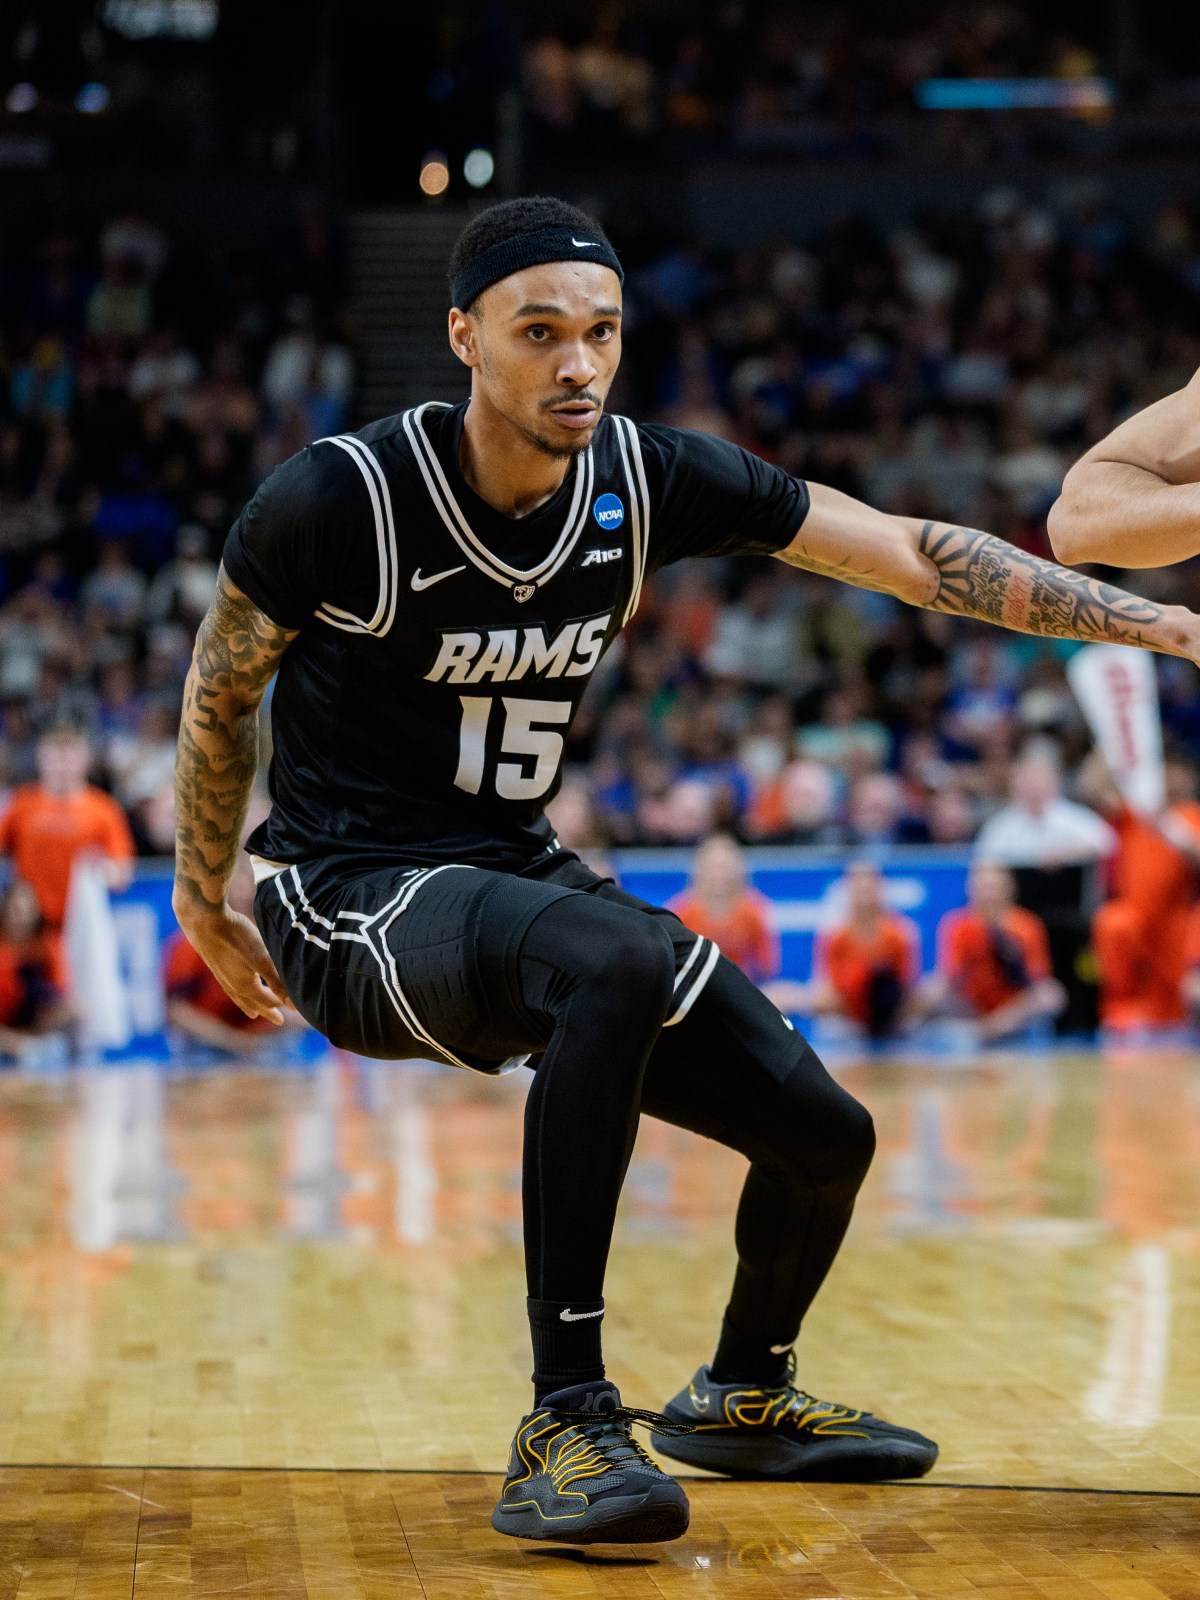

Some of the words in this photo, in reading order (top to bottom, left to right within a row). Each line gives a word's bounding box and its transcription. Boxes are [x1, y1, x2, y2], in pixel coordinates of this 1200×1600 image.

[598, 508, 623, 522] NCAA
[423, 613, 612, 684] RAMS
[453, 695, 573, 801] 15
